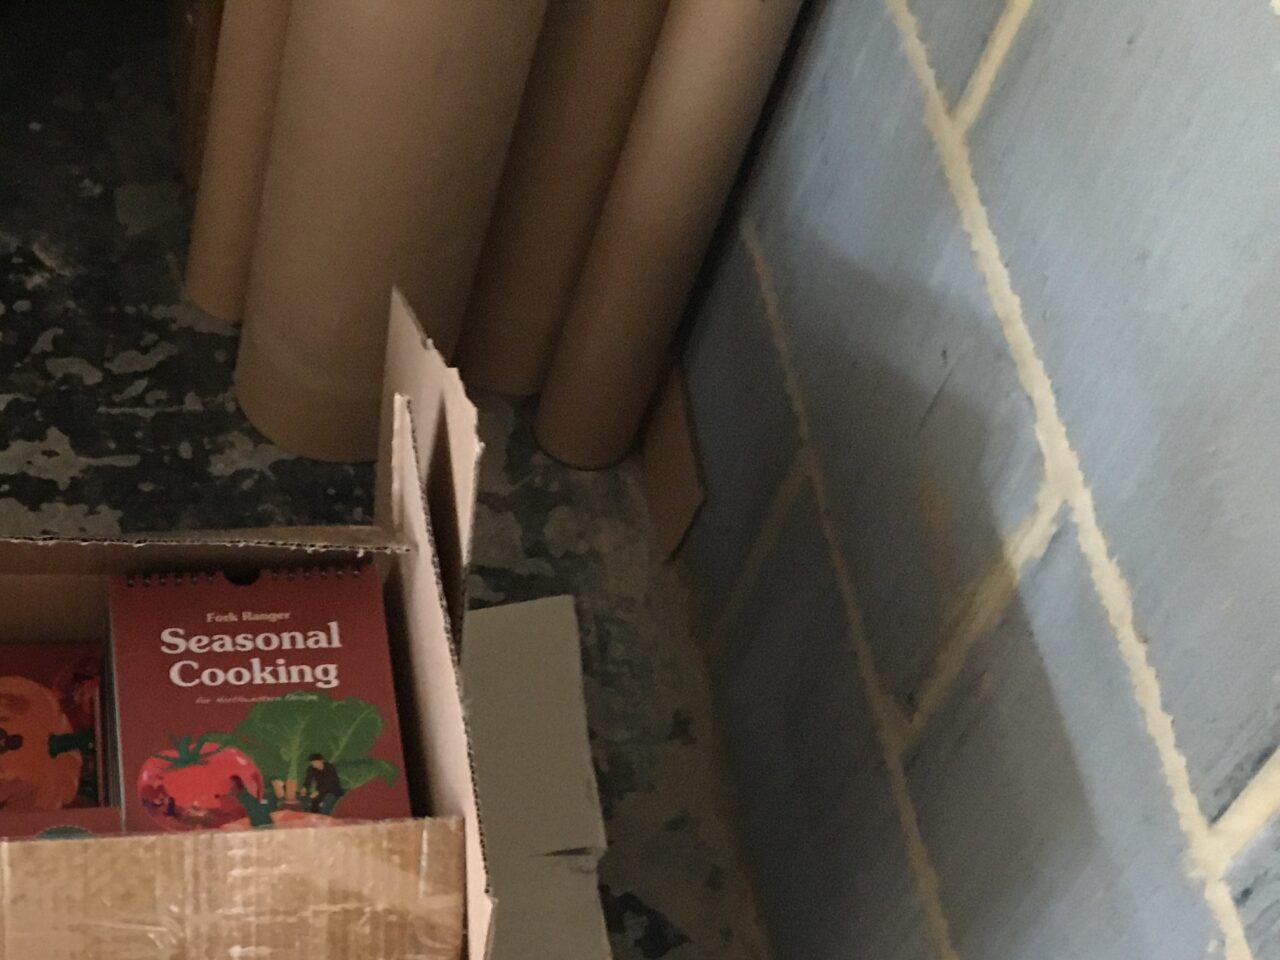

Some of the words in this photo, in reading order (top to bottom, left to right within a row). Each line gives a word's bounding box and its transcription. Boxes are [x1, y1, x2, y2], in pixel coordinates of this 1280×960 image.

[206, 612, 238, 624] Fork
[242, 610, 291, 623] Ranger
[160, 621, 342, 655] Seasonal
[169, 657, 340, 689] Cooking
